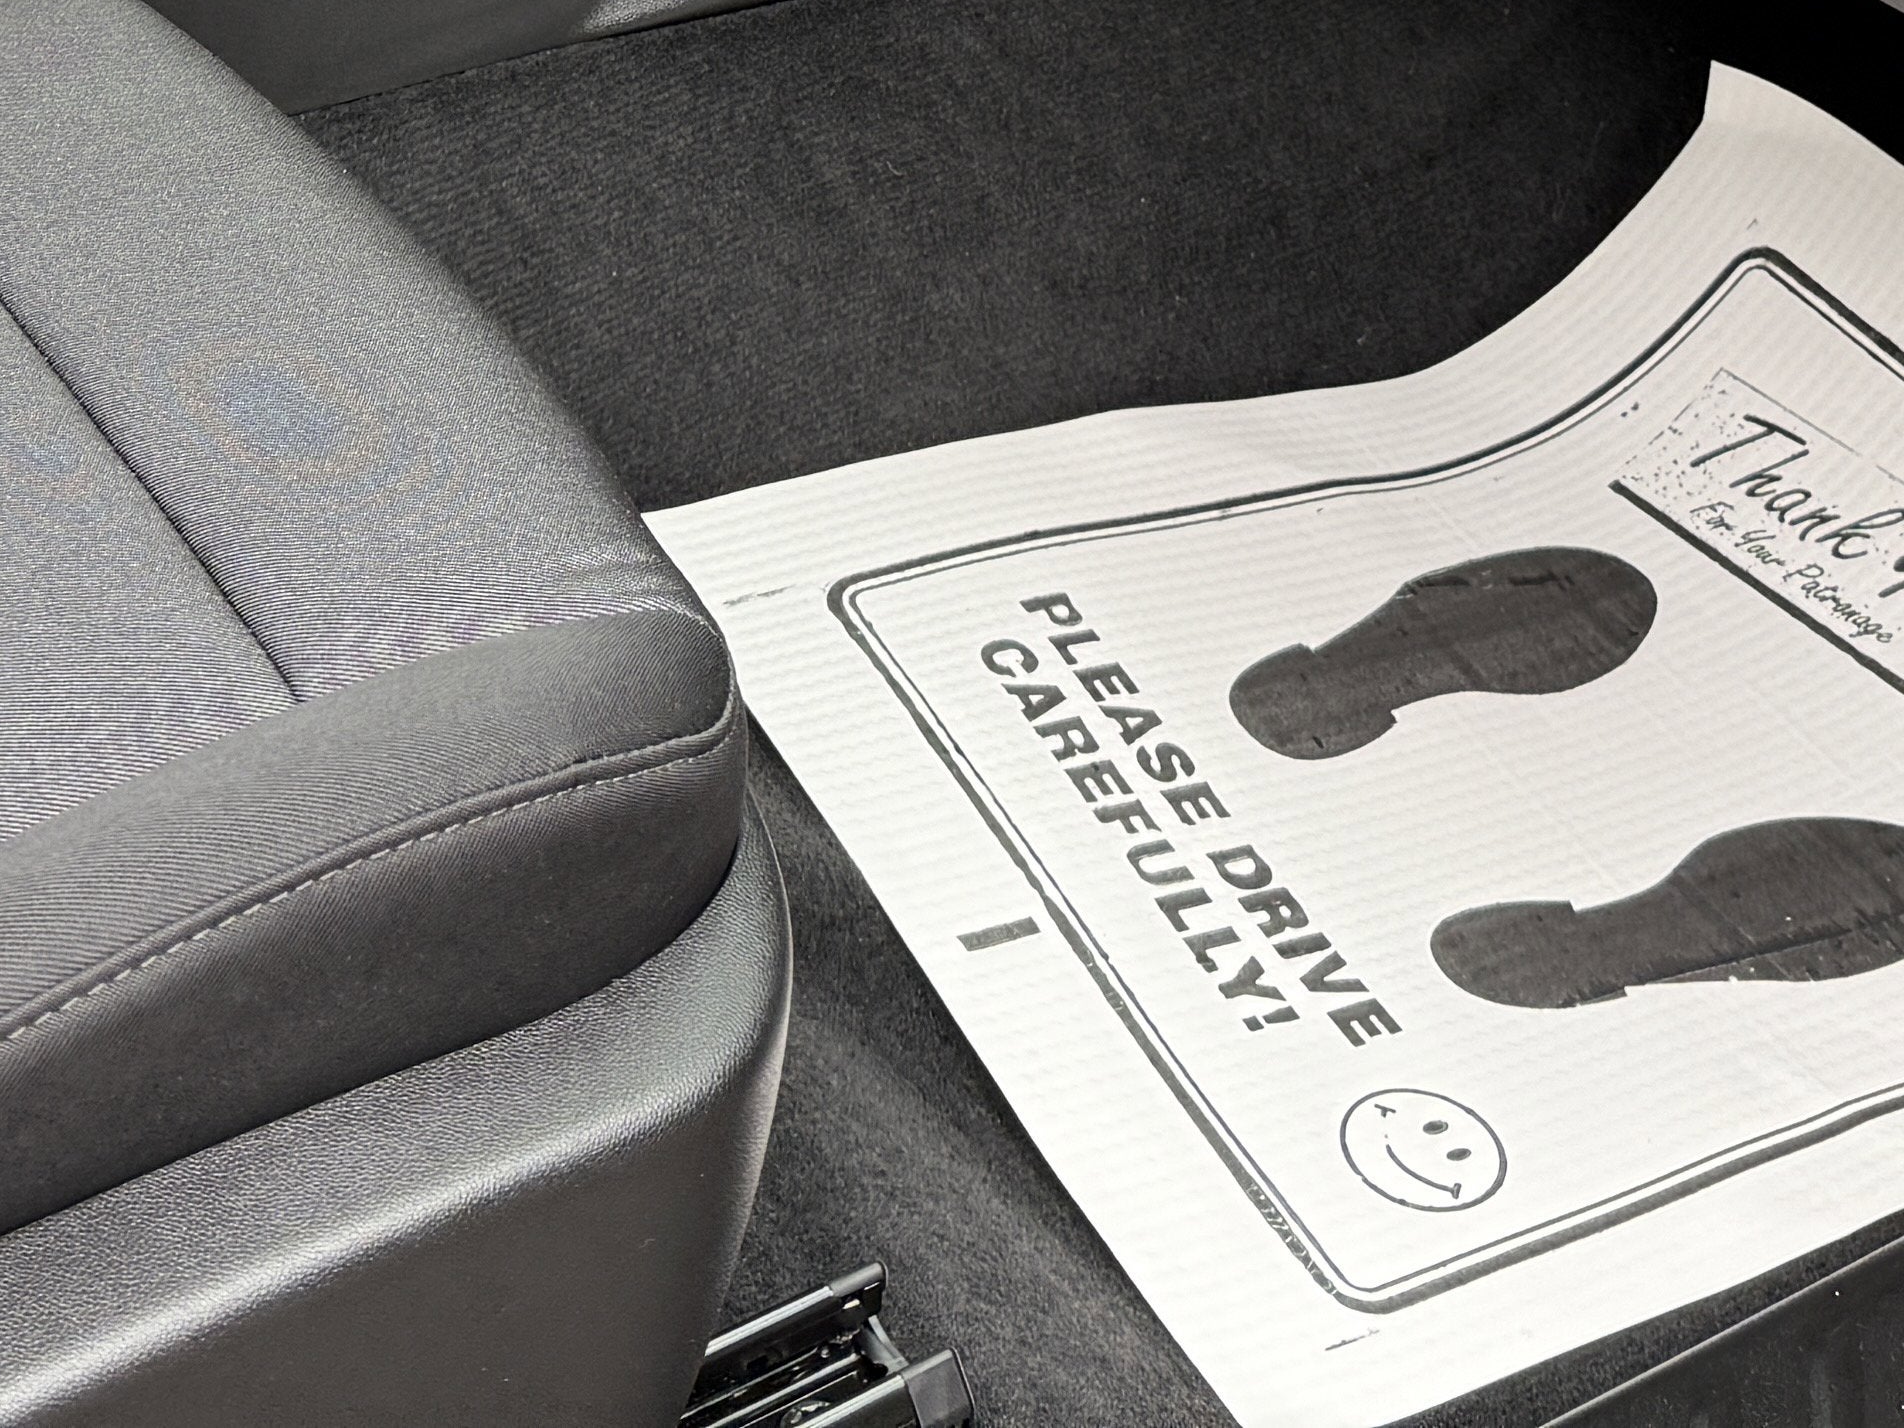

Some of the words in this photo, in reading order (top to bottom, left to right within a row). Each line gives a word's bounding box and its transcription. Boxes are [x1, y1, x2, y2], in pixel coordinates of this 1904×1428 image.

[1689, 499, 1735, 533] For
[1734, 528, 1786, 567] Your
[1782, 562, 1896, 645] Patronage
[980, 637, 1301, 1032] CAREFULLY!
[1019, 591, 1232, 826] PLEASE
[1205, 843, 1404, 1048] DRIVE
